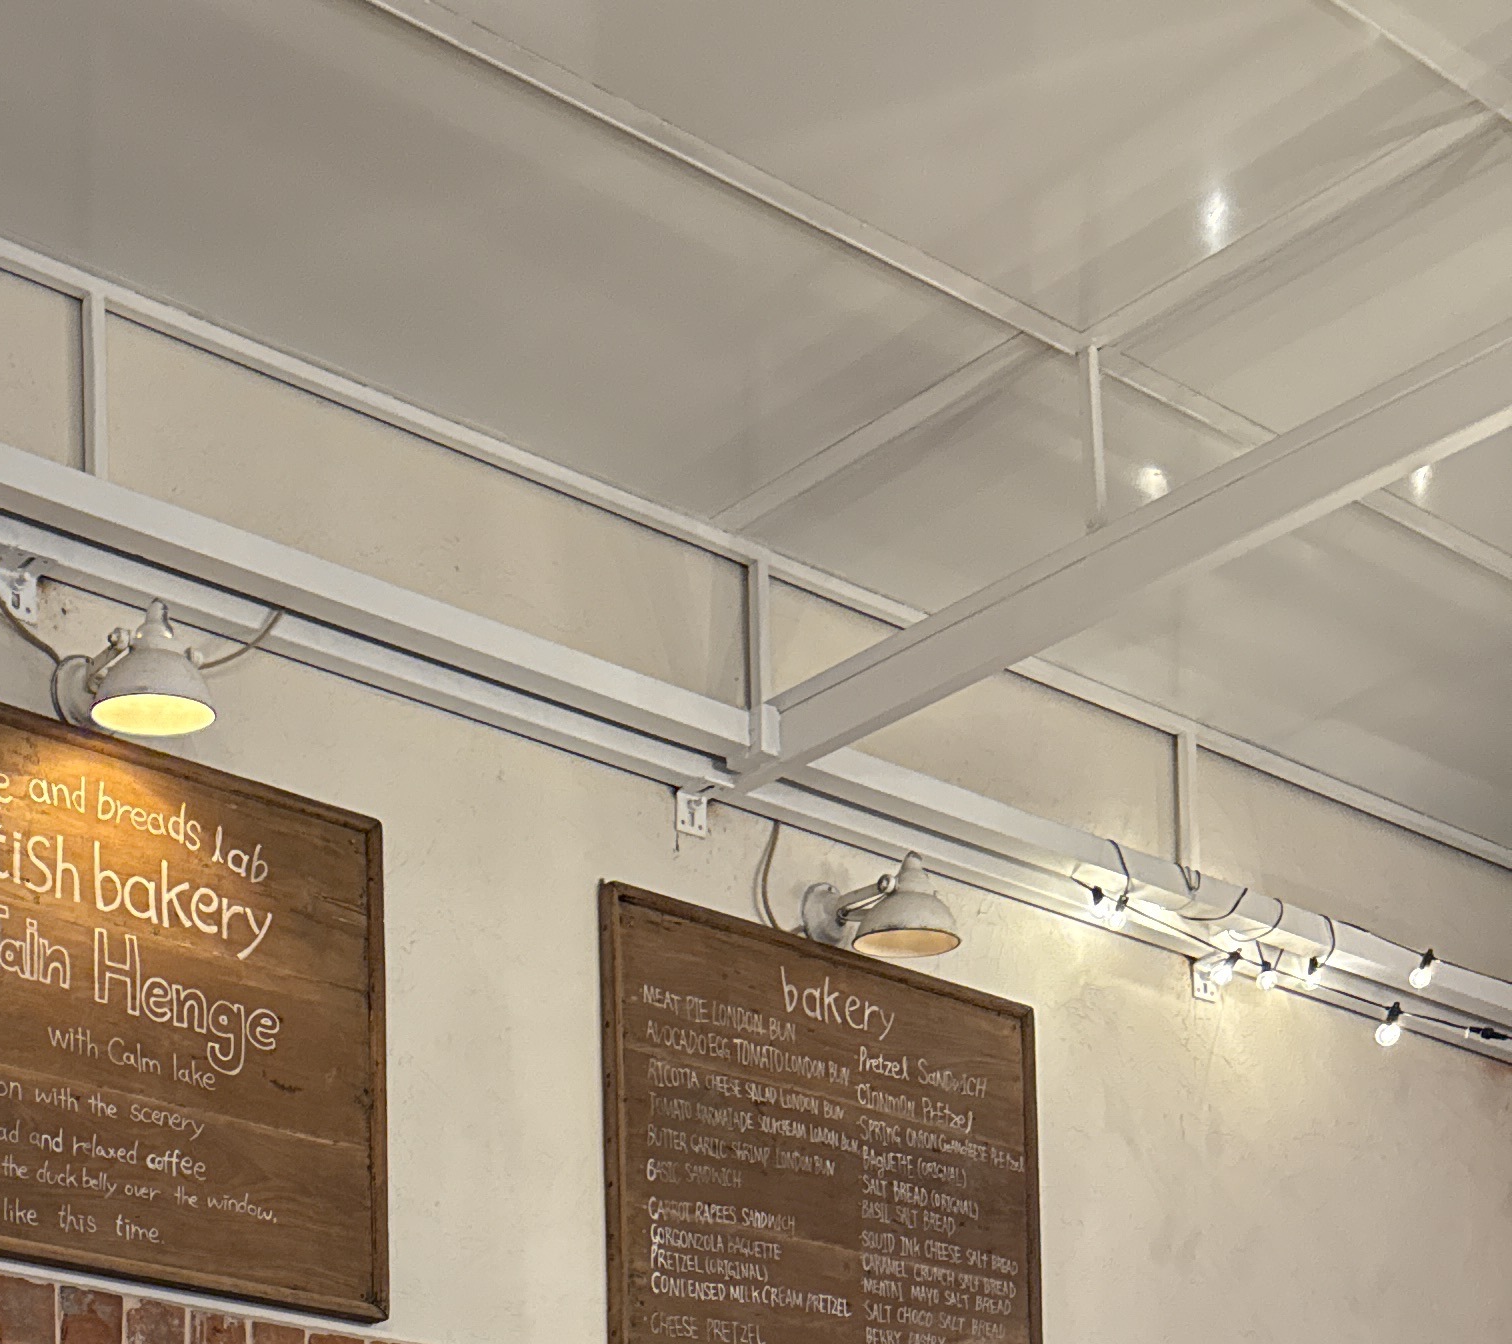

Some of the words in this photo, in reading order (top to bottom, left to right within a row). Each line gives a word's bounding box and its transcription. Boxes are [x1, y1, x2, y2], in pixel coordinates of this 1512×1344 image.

[29, 776, 85, 813] and
[97, 781, 201, 851] breads
[212, 826, 268, 883] lab
[94, 841, 272, 960] bakery
[94, 928, 279, 1075] Henge
[644, 985, 681, 1015] MEAT
[687, 996, 709, 1022] PIE
[769, 1018, 795, 1043] BUN
[781, 966, 894, 1040] bakery
[48, 1026, 98, 1058] with
[173, 1054, 216, 1090] lake
[647, 1020, 706, 1054] AVOCADO
[709, 1033, 730, 1059] EGG
[733, 1039, 783, 1073] TOMATO
[35, 1088, 79, 1113] with
[88, 1093, 117, 1119] the
[130, 1103, 204, 1140] scenery
[2, 1154, 28, 1179] the
[37, 1162, 77, 1188] duck
[82, 1170, 117, 1198] belly
[125, 1183, 161, 1201] over
[175, 1186, 198, 1208] the
[30, 1129, 63, 1153] and
[73, 1133, 138, 1165] relaxed
[146, 1145, 206, 1181] coffee
[4, 1199, 39, 1226] like
[58, 1205, 97, 1233] this
[862, 1175, 887, 1196] SALT
[894, 1181, 928, 1207] BREAD
[651, 1223, 723, 1253] GORGONZOLA
[651, 1245, 704, 1273] PRETZEL
[651, 1272, 725, 1301] CONDENSED
[762, 1286, 802, 1307] CREAM
[806, 1293, 852, 1317] PRETZEL
[864, 1300, 891, 1323] SALT
[939, 1313, 965, 1333] SALT
[650, 1312, 698, 1339] CHEESE
